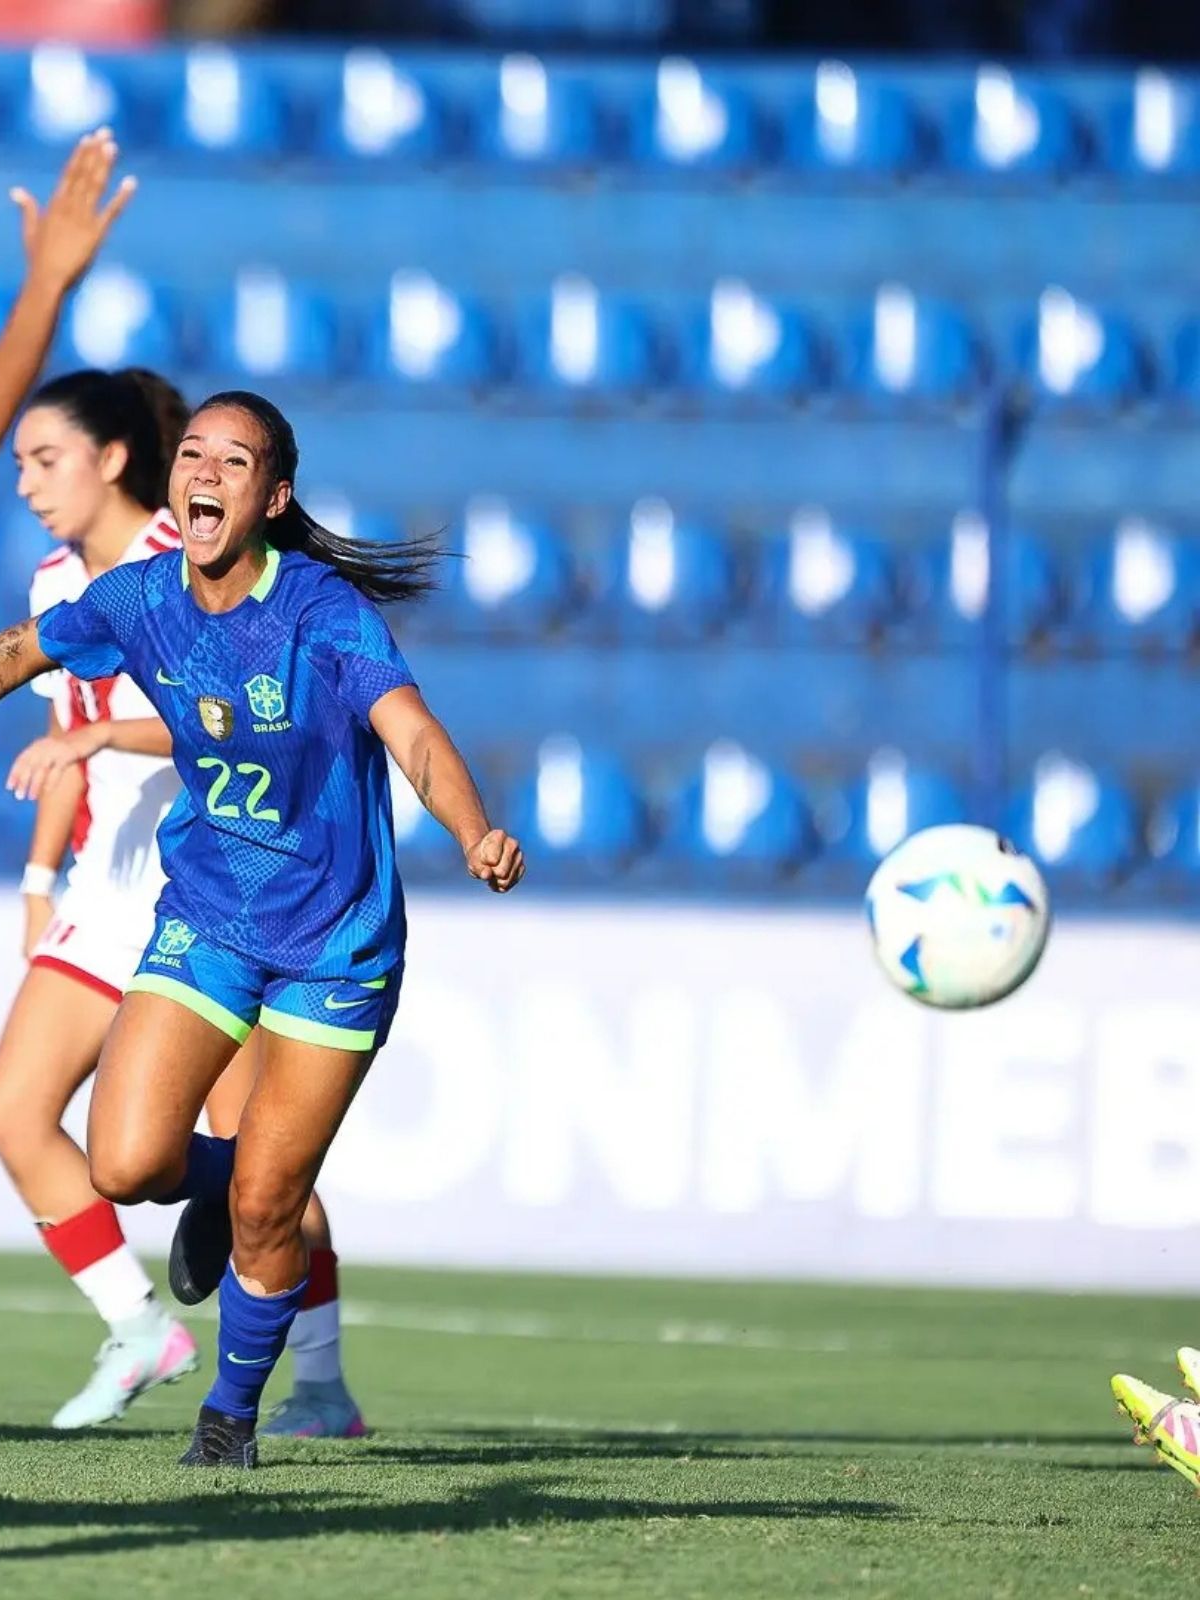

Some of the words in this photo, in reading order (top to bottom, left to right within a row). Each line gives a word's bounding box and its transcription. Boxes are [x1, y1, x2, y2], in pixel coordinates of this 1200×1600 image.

[252, 720, 292, 734] BRASIL
[196, 756, 281, 823] 22
[147, 953, 183, 969] BRASIL
